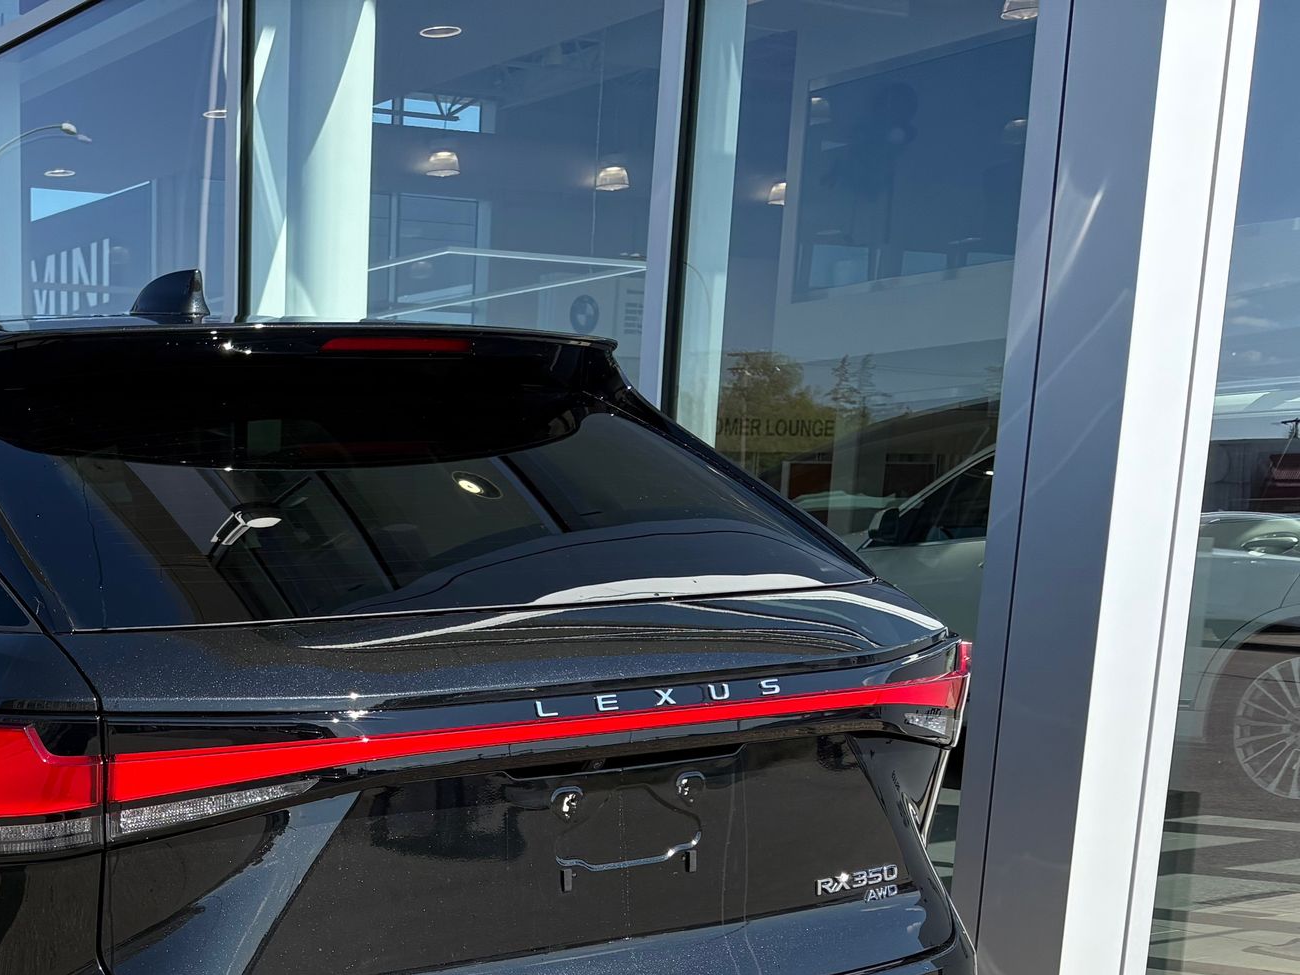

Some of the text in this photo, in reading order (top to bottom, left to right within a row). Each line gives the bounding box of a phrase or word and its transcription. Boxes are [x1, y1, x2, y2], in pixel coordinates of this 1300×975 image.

[766, 419, 836, 437] LOUNGE
[535, 678, 781, 718] LEXUS
[864, 884, 898, 903] AWD
